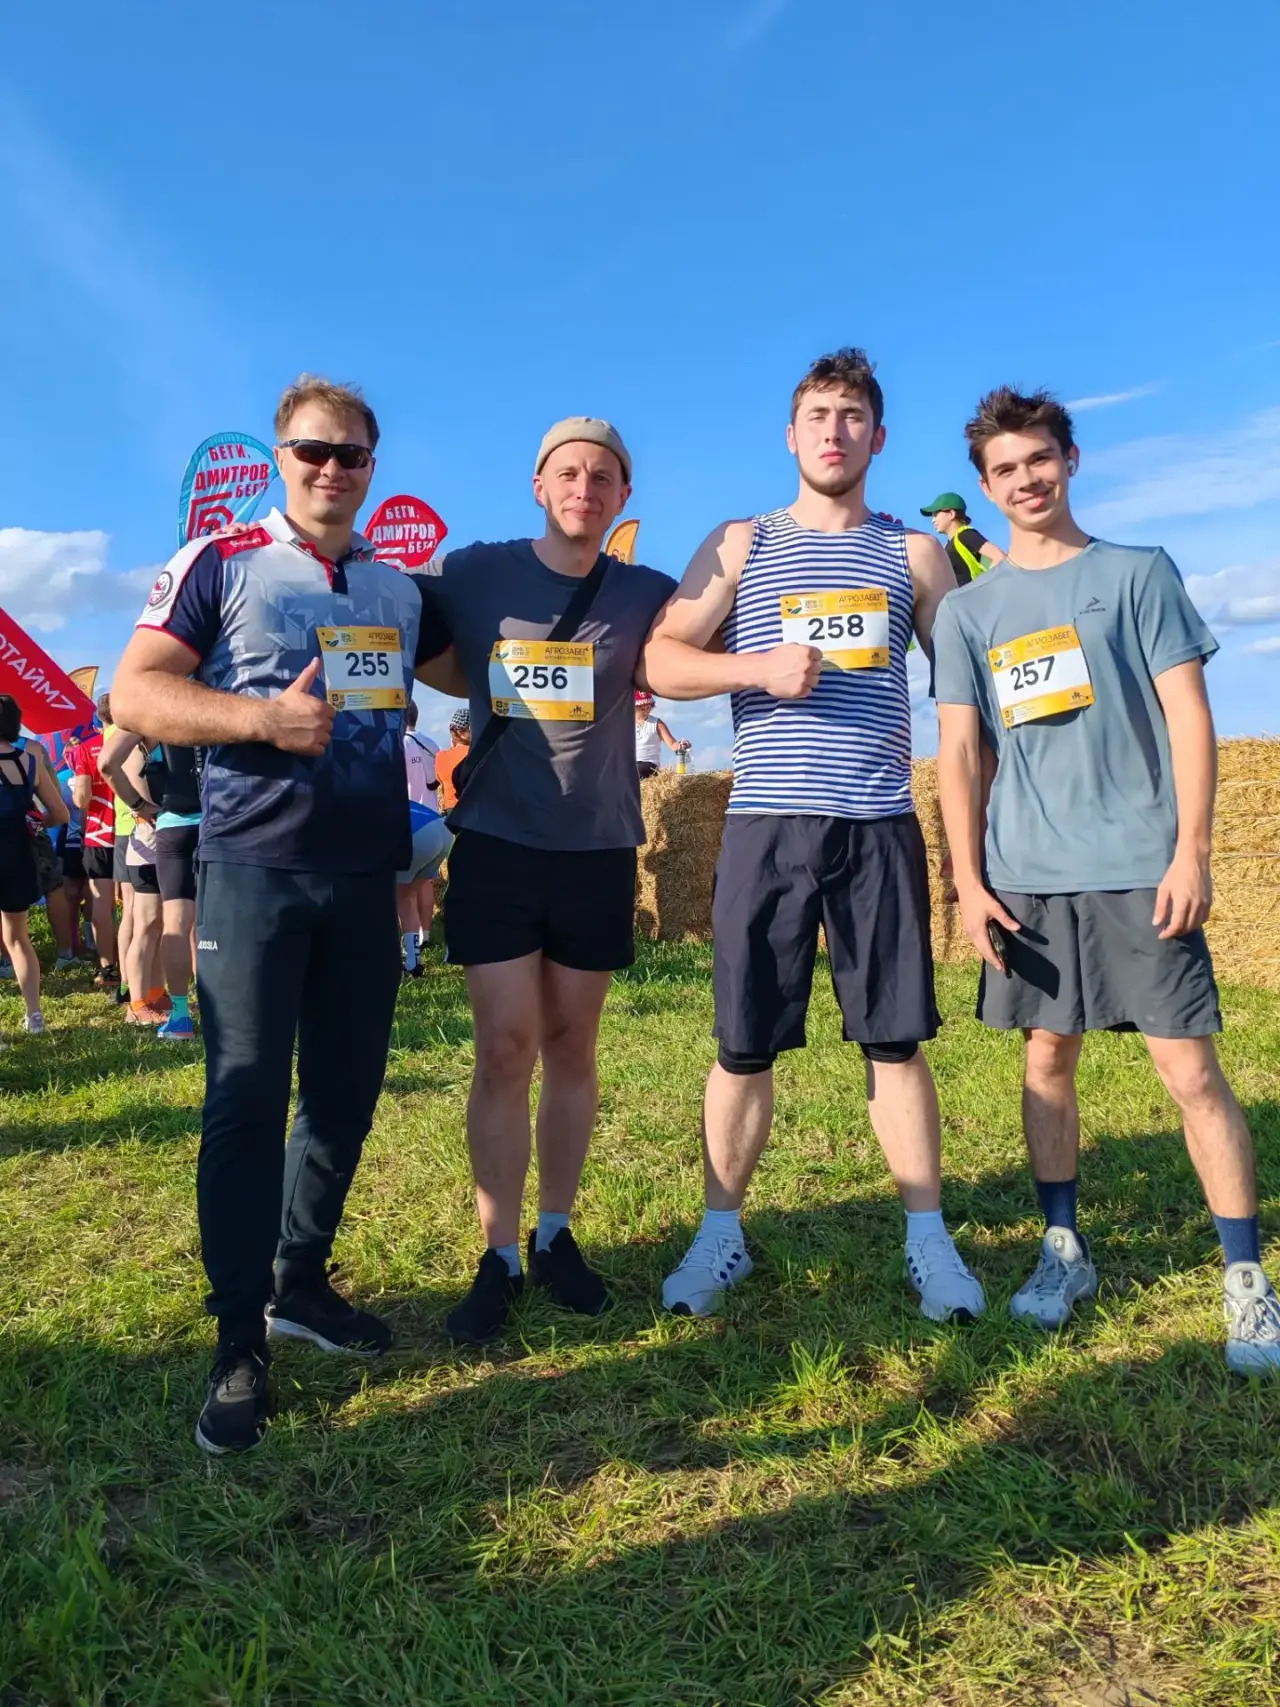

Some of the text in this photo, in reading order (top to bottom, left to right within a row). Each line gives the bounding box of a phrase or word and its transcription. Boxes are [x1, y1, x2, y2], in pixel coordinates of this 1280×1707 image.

[208, 444, 251, 462] БЕГИ,
[194, 463, 270, 493] ДМИТРОВ
[385, 505, 420, 520] БЕГИ,
[371, 523, 436, 543] ДМИТРОВ
[807, 614, 864, 641] 258
[345, 652, 389, 677] 255
[1010, 655, 1055, 691] 257
[513, 665, 568, 689] 256
